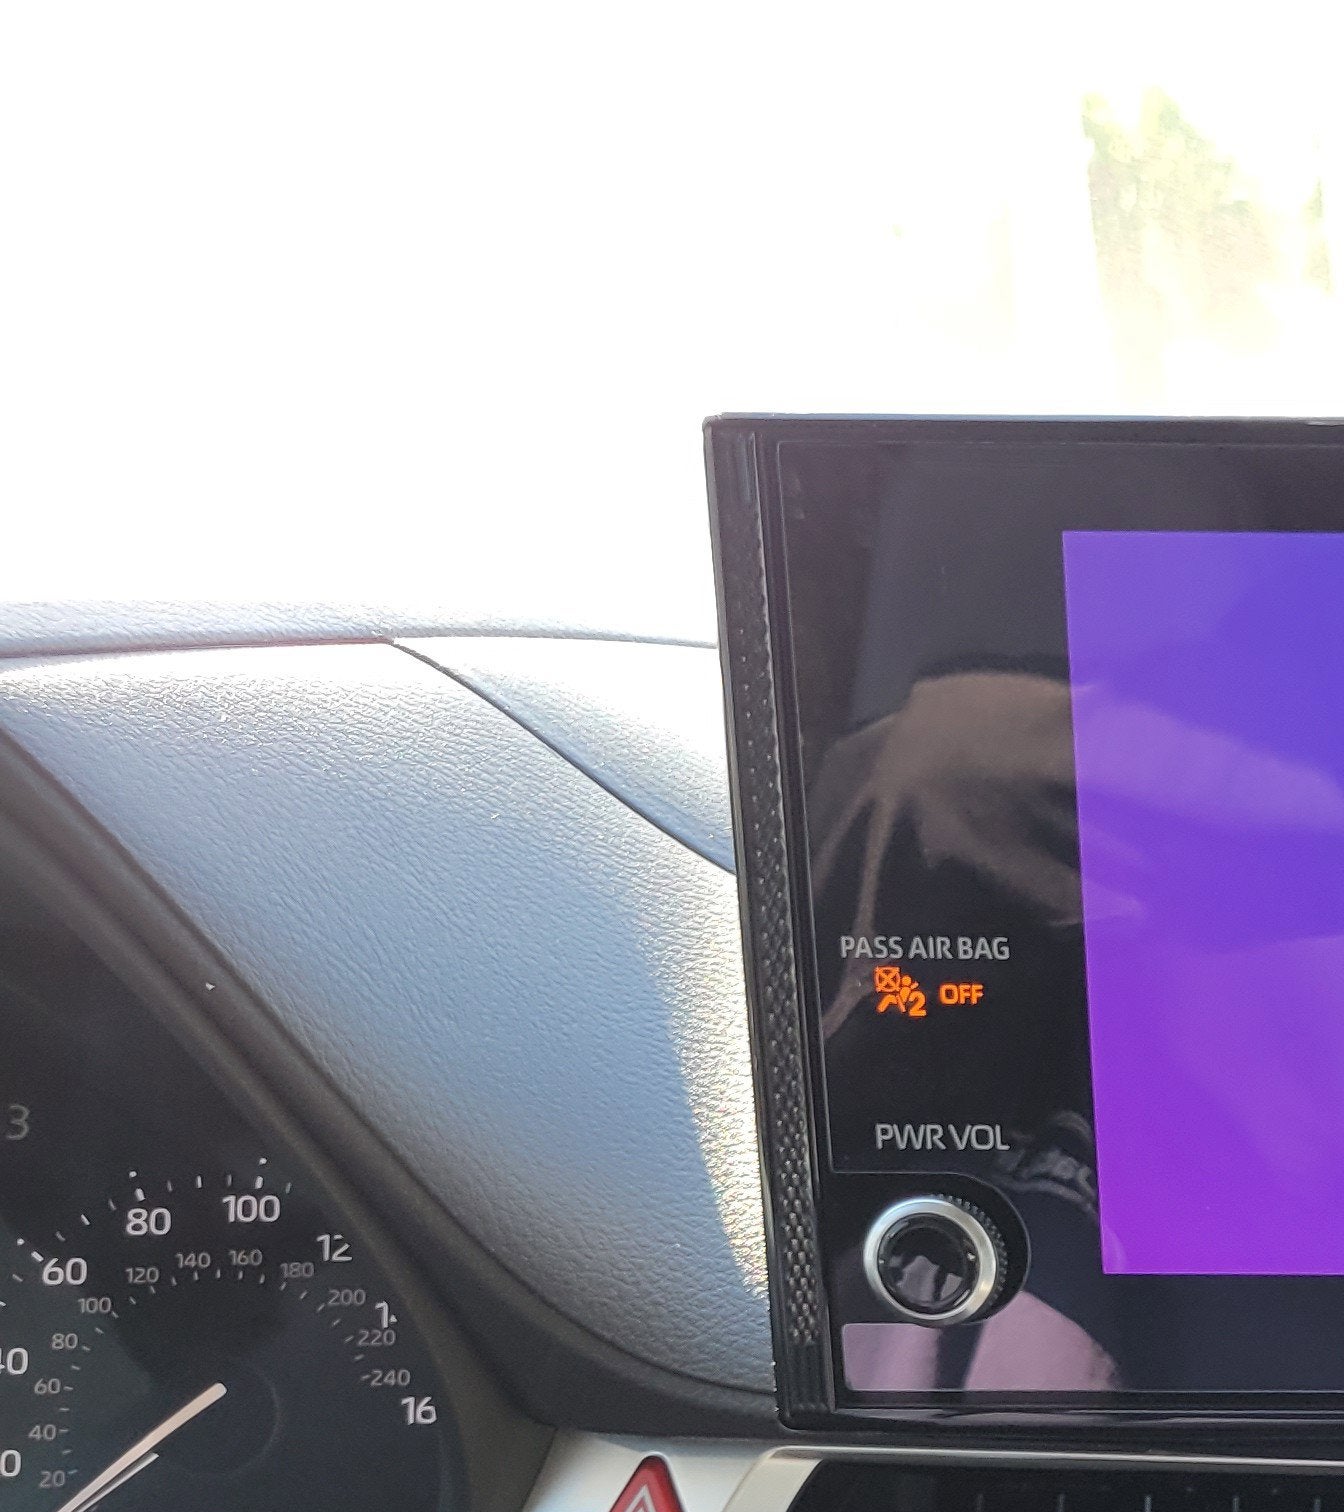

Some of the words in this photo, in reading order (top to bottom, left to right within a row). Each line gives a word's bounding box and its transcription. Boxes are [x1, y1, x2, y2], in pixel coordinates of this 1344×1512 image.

[840, 936, 902, 959] PASS
[908, 936, 952, 960] AIR
[957, 936, 1010, 960] BAG
[939, 983, 984, 1006] OFF
[6, 1104, 30, 1140] 3
[875, 1124, 946, 1151] PWR
[949, 1124, 1010, 1151] VOL
[222, 1194, 281, 1223] 100
[126, 1207, 172, 1235] 80
[175, 1252, 211, 1269] 140
[229, 1249, 263, 1266] 160
[42, 1257, 88, 1286] 60
[125, 1267, 160, 1284] 120
[280, 1262, 315, 1278] 180
[78, 1297, 112, 1314] 100
[328, 1289, 366, 1306] 200
[51, 1333, 78, 1350] 80
[357, 1329, 396, 1346] 220
[34, 1378, 61, 1395] 60
[370, 1369, 411, 1387] 240
[401, 1396, 438, 1425] 16
[28, 1424, 56, 1441] 40
[39, 1469, 66, 1488] 20
